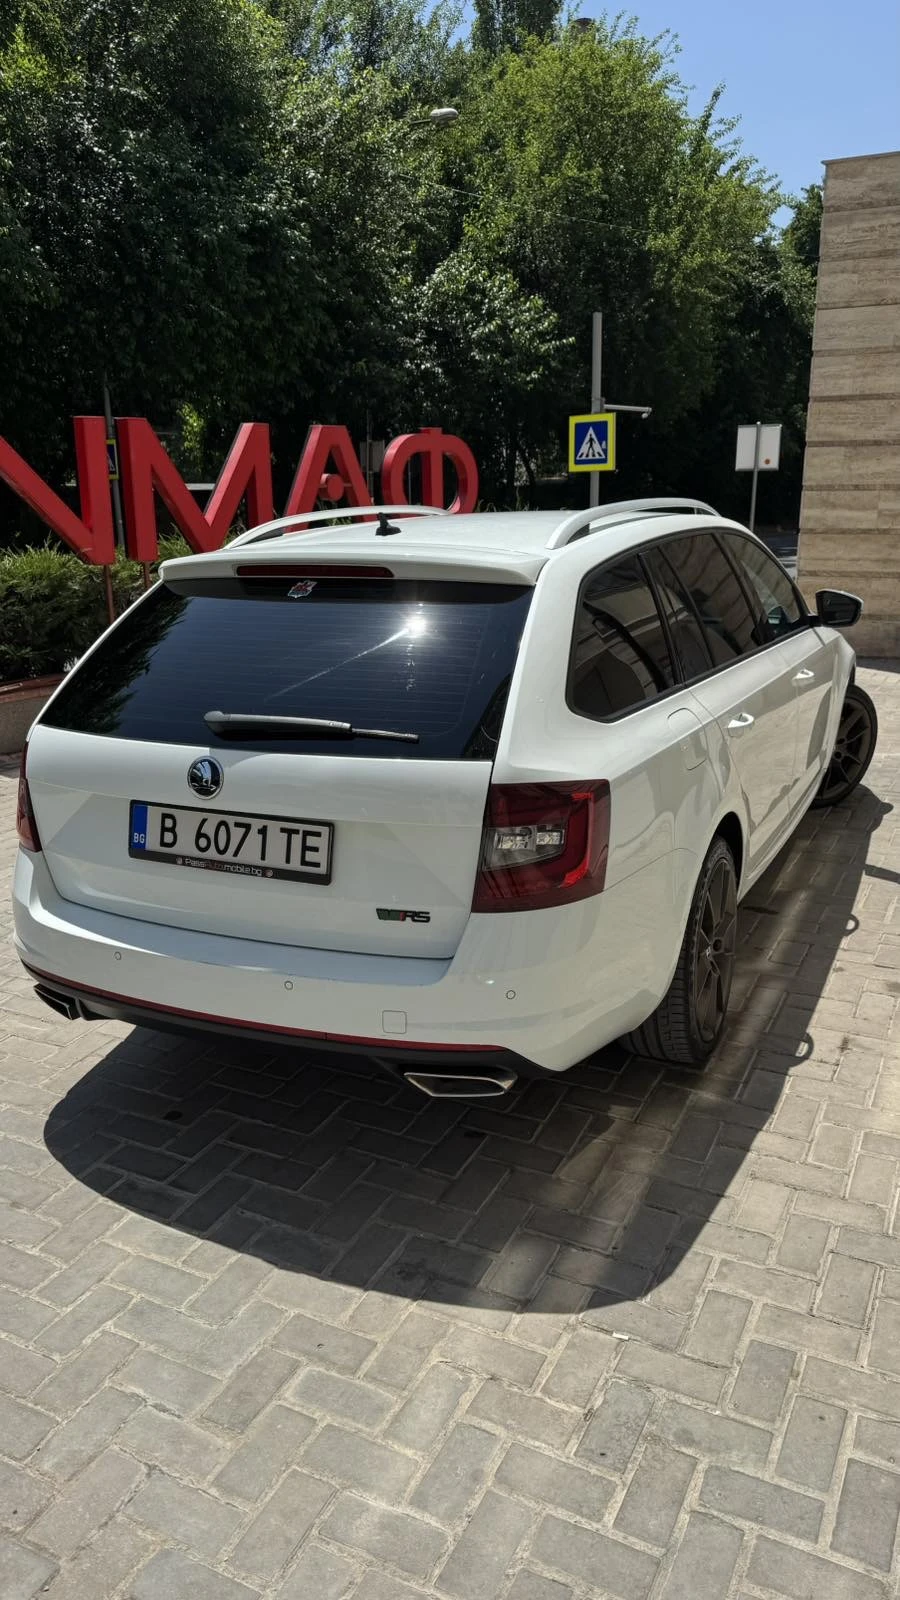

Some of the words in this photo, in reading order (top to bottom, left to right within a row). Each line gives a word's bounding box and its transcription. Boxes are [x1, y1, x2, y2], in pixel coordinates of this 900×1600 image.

[133, 832, 145, 844] BG
[160, 812, 178, 849] B
[194, 818, 268, 861] 6071
[279, 827, 322, 869] TE
